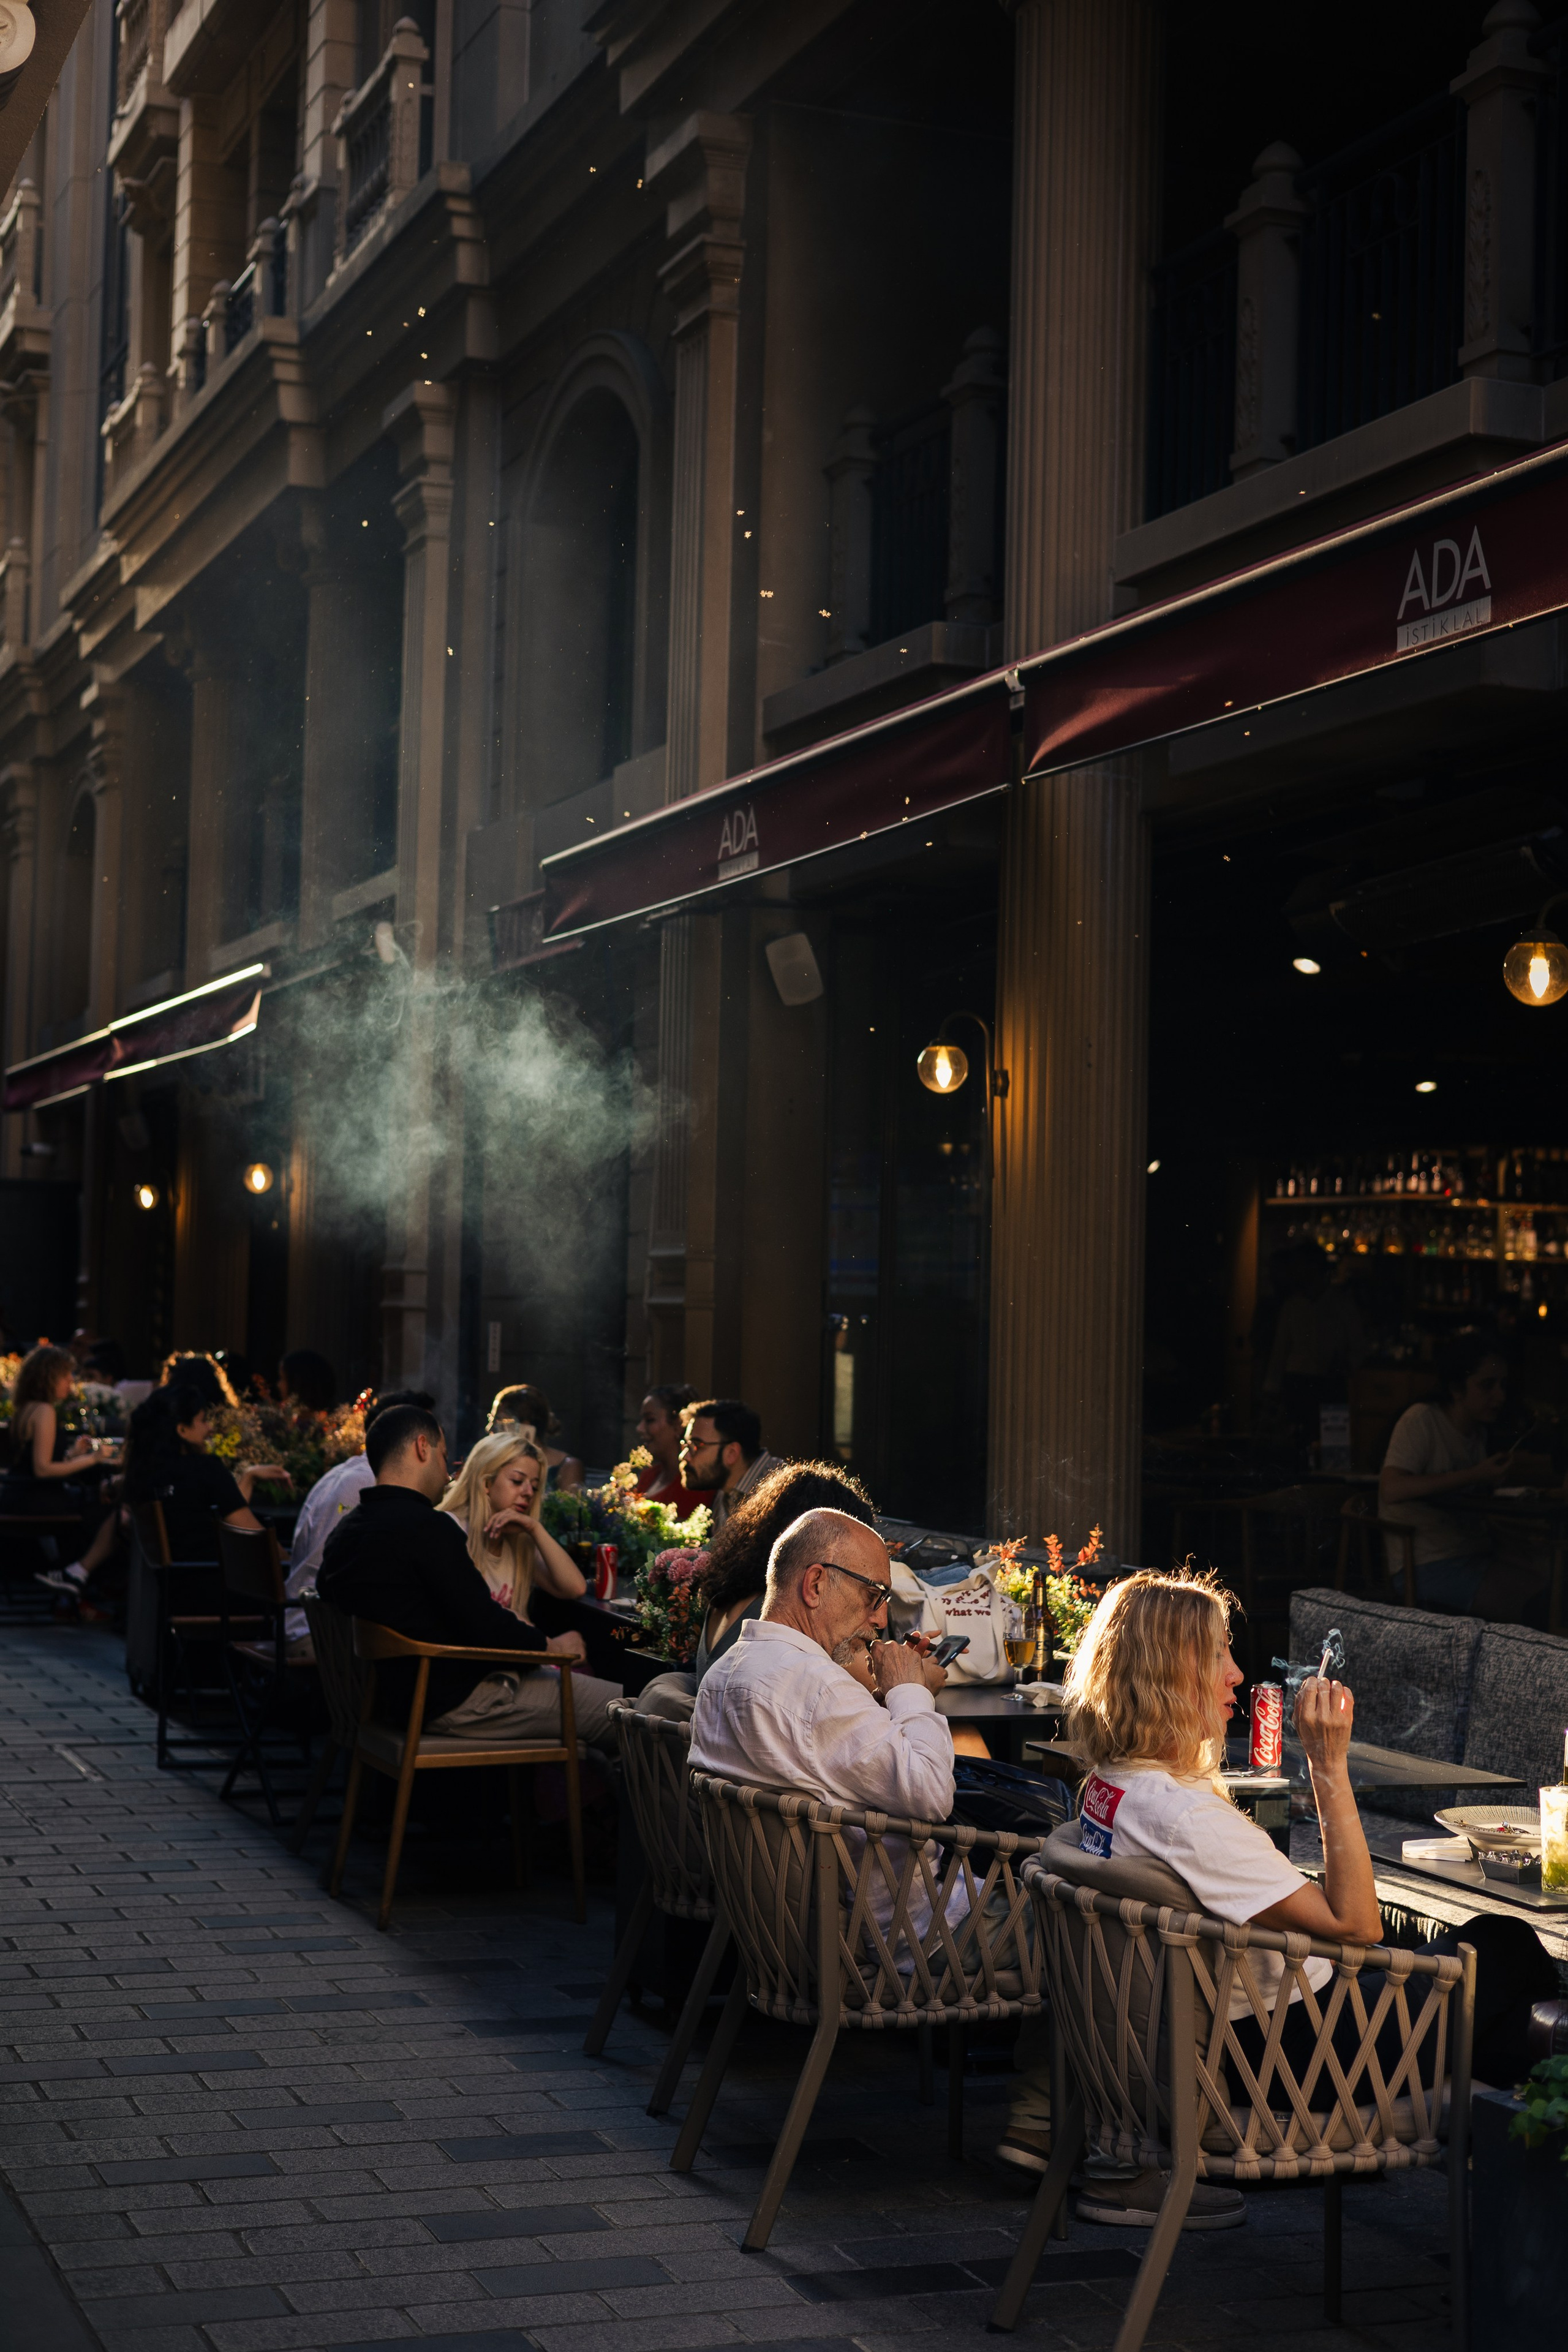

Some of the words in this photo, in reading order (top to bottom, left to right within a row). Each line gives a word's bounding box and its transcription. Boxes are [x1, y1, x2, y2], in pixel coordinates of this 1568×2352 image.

[1397, 525, 1491, 620] ADA
[1406, 608, 1482, 647] İSTİKLAL
[718, 804, 760, 860] ADA
[945, 1608, 972, 1616] what
[1036, 1640, 1050, 1651] ES
